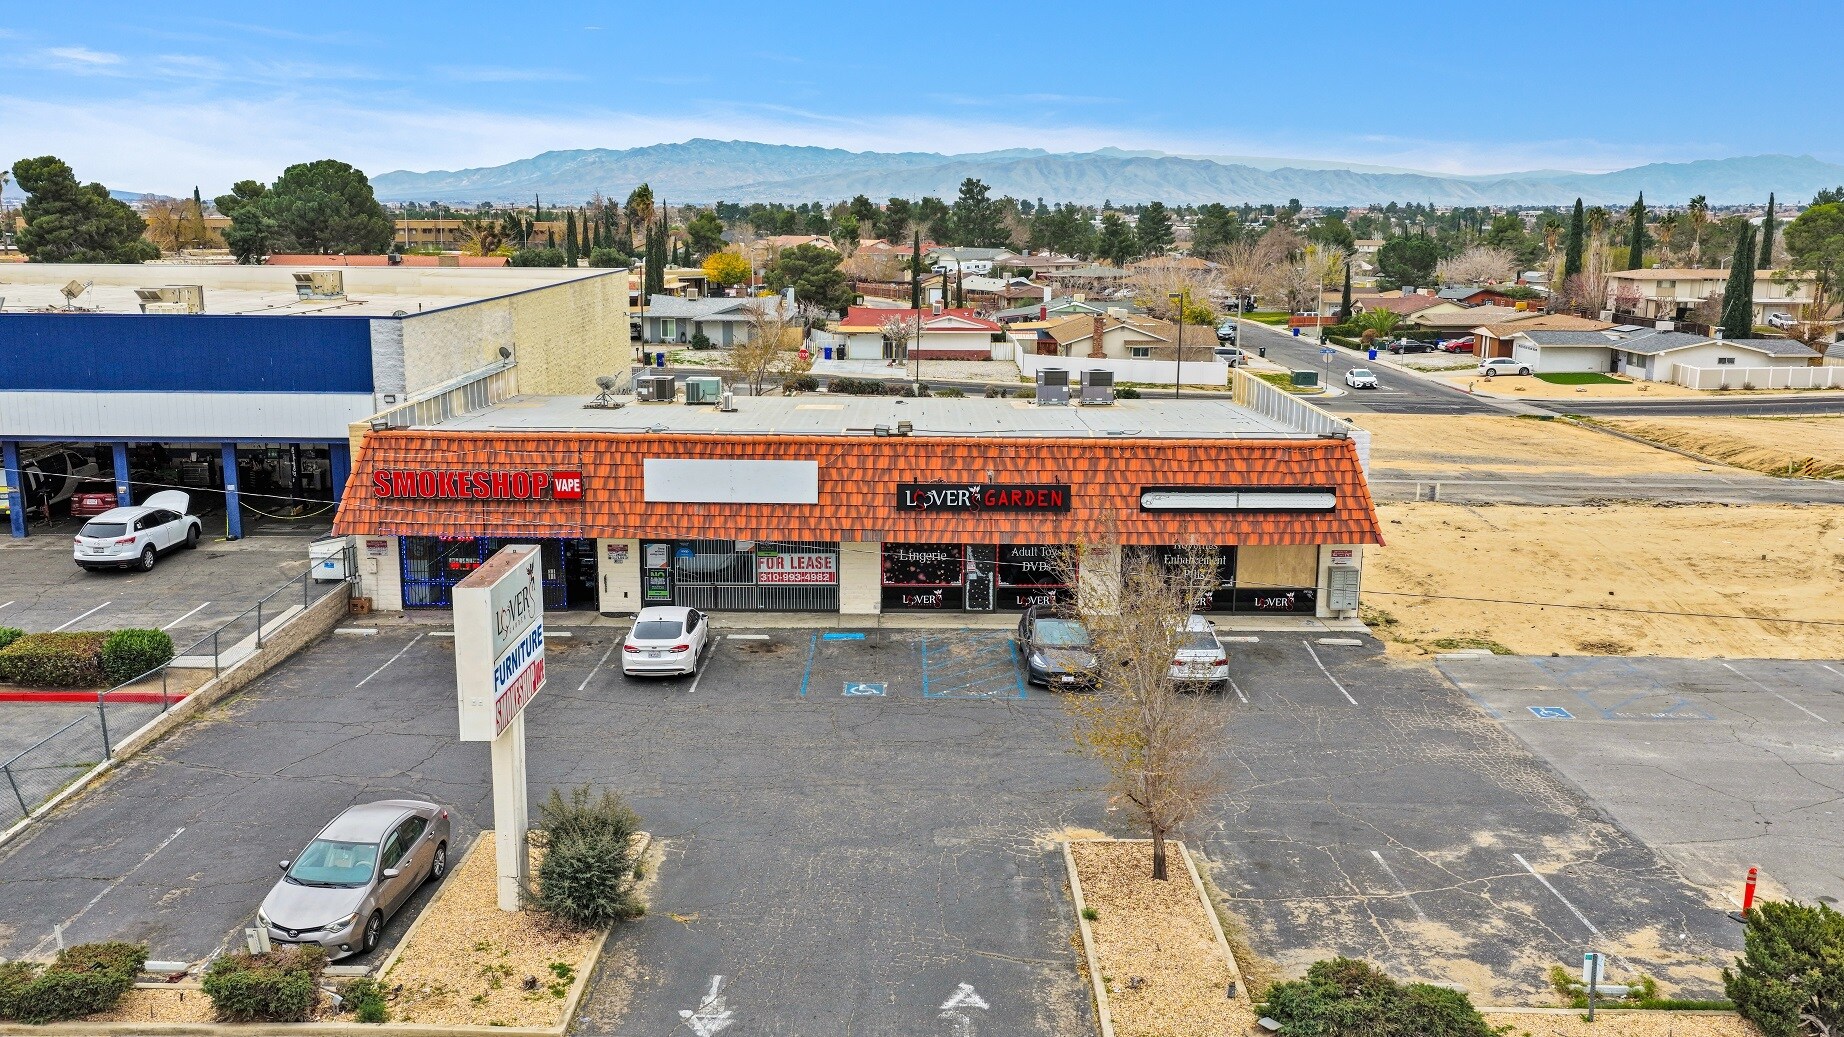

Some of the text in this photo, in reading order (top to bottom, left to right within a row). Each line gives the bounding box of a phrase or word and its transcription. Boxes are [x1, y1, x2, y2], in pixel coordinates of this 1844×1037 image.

[373, 470, 581, 499] SMOKESHOP VAPE
[984, 489, 1063, 507] GARDEN
[899, 550, 947, 563] Lingerie
[1011, 547, 1038, 557] Adult
[757, 556, 832, 570] FOR LEASE
[1022, 561, 1051, 572] DVDs
[760, 573, 830, 582] 310-993-4982
[493, 623, 543, 693] FURNITURE
